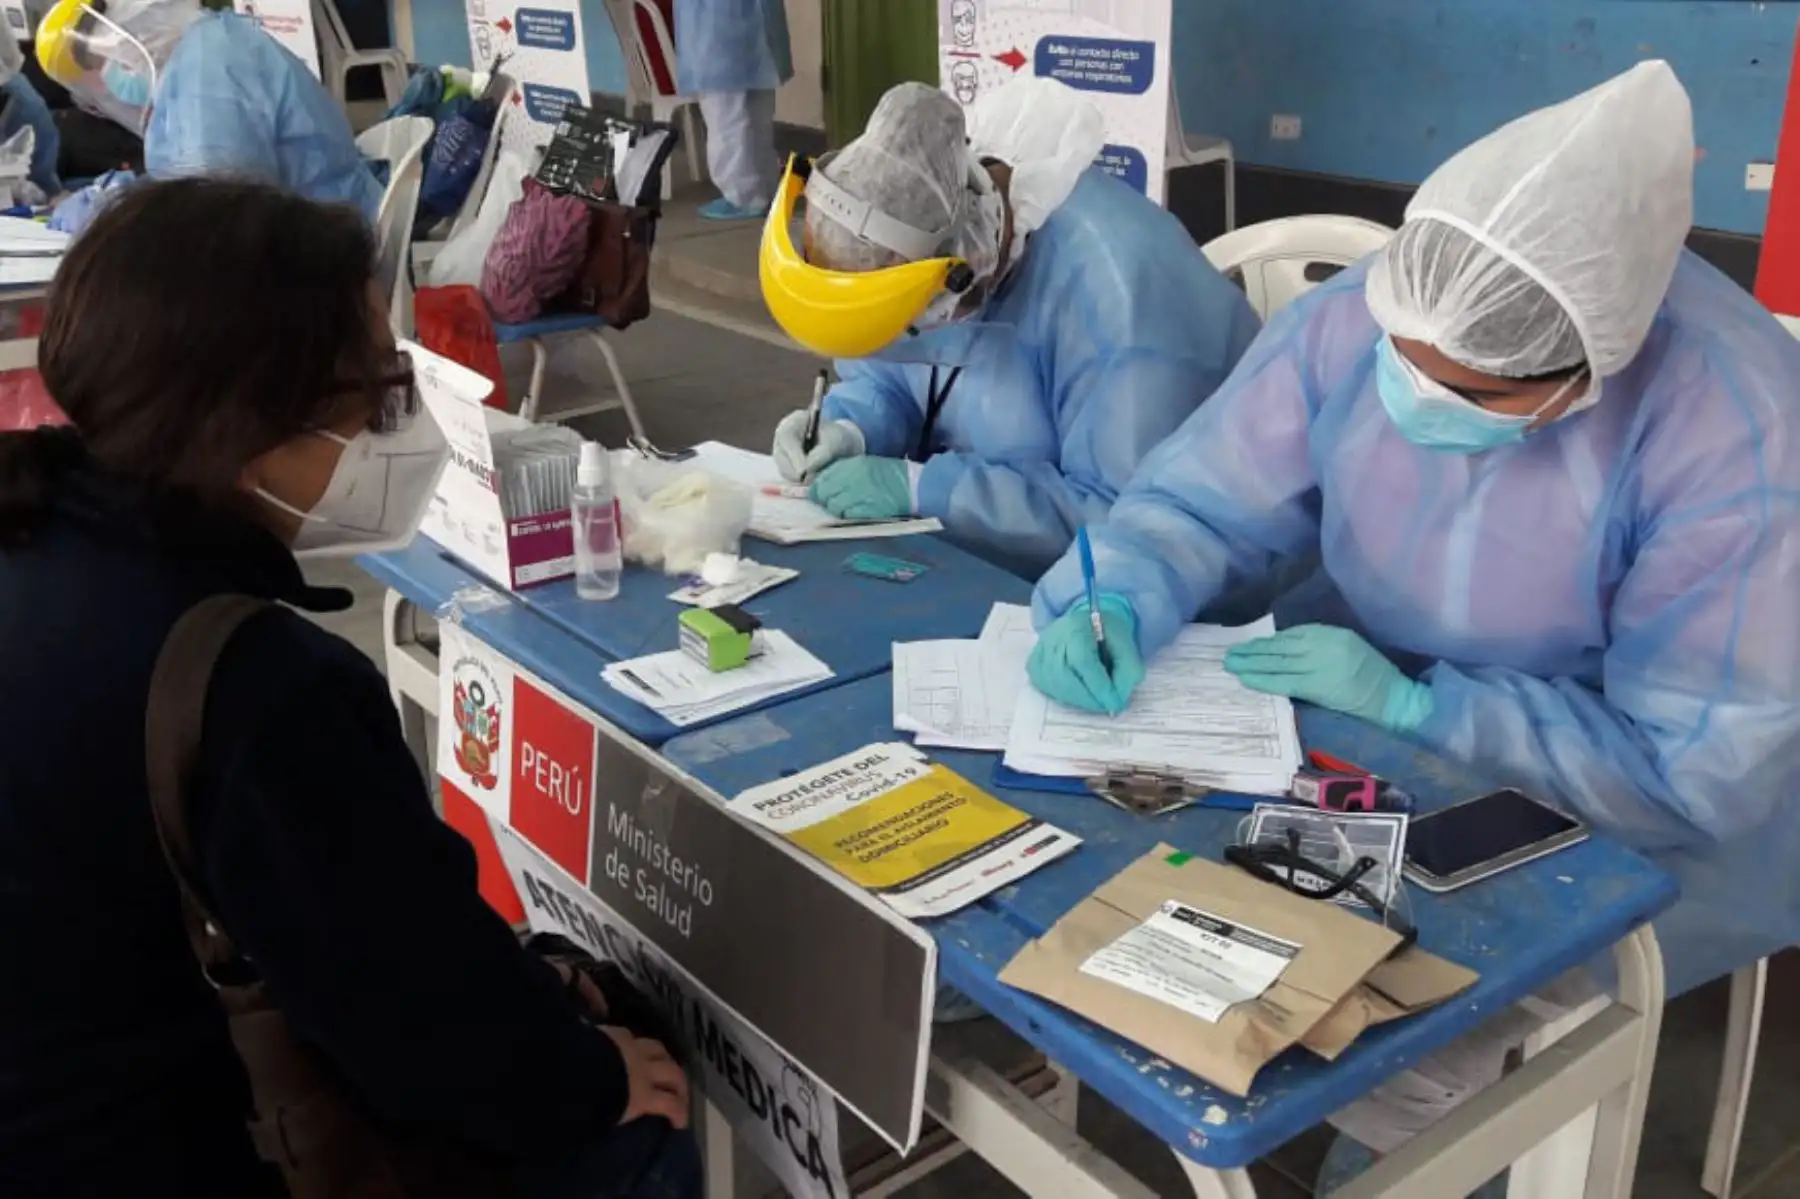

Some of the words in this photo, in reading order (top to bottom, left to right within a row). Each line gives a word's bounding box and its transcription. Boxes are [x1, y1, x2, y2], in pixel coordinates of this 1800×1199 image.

[521, 741, 583, 816] PERÚ
[752, 768, 855, 812] PROTÉGETE
[854, 753, 890, 772] DEL
[767, 770, 883, 820] CORONAVIRUS
[846, 766, 918, 802] Covid-19
[834, 790, 954, 848] RECOMENDACIONES
[844, 838, 880, 856] PARA
[858, 818, 950, 863] DOMICILIARIO
[607, 801, 713, 906] Ministerio
[605, 847, 630, 888] de
[634, 867, 693, 939] Salud
